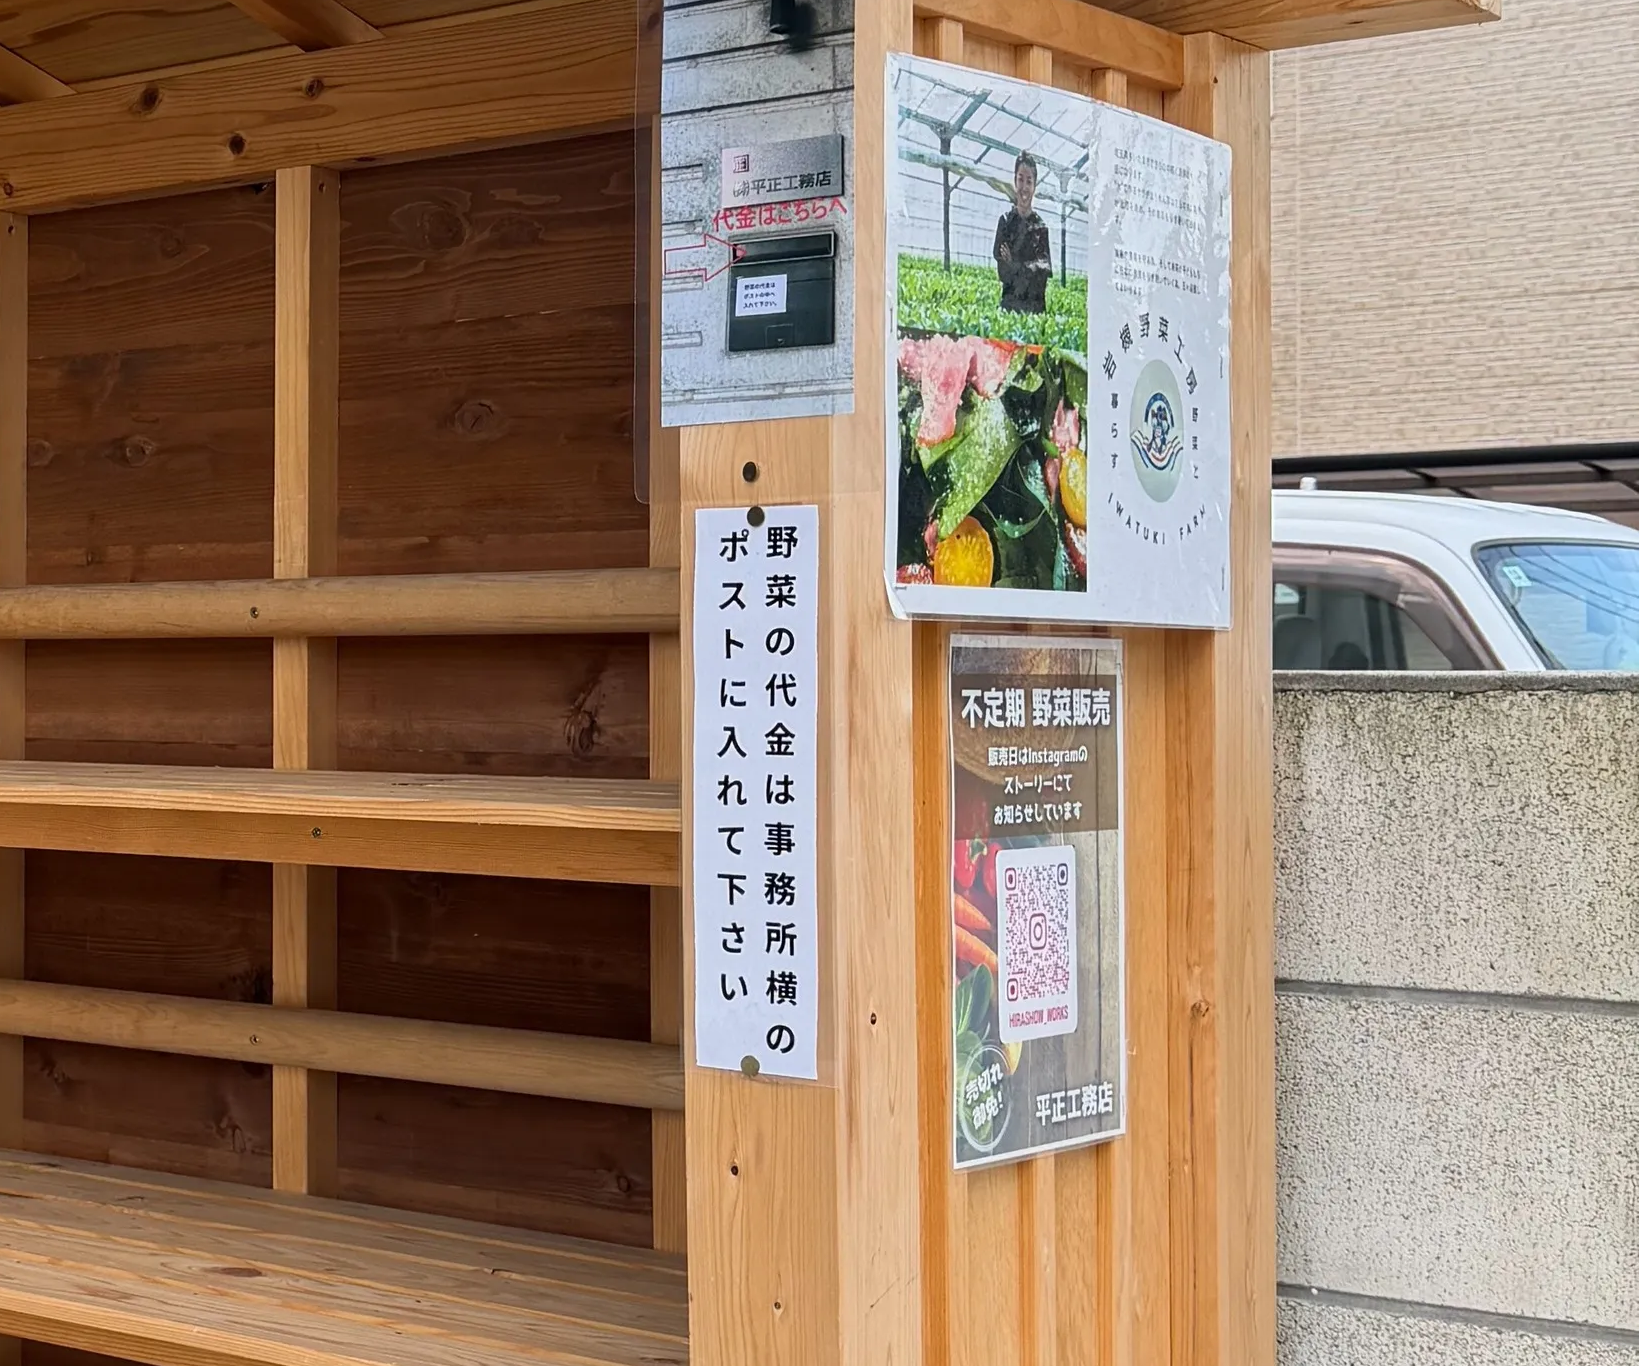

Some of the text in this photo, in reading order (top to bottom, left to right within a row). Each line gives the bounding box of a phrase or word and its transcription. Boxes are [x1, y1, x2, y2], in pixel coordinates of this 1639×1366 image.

[1108, 492, 1206, 546] IWATUKI FARM
[961, 687, 1111, 729] 不定期 野菜販売
[717, 528, 750, 1002] ポストに入れて下さい
[987, 746, 1089, 768] 販売日はInstagramの
[763, 525, 799, 1056] 野菜の代金は事務所横の
[1004, 774, 1074, 795] ストーリーにて
[994, 801, 1083, 826] お知らせしています
[965, 1062, 1004, 1106] 売切れ
[1035, 1081, 1114, 1127] 平正工務店
